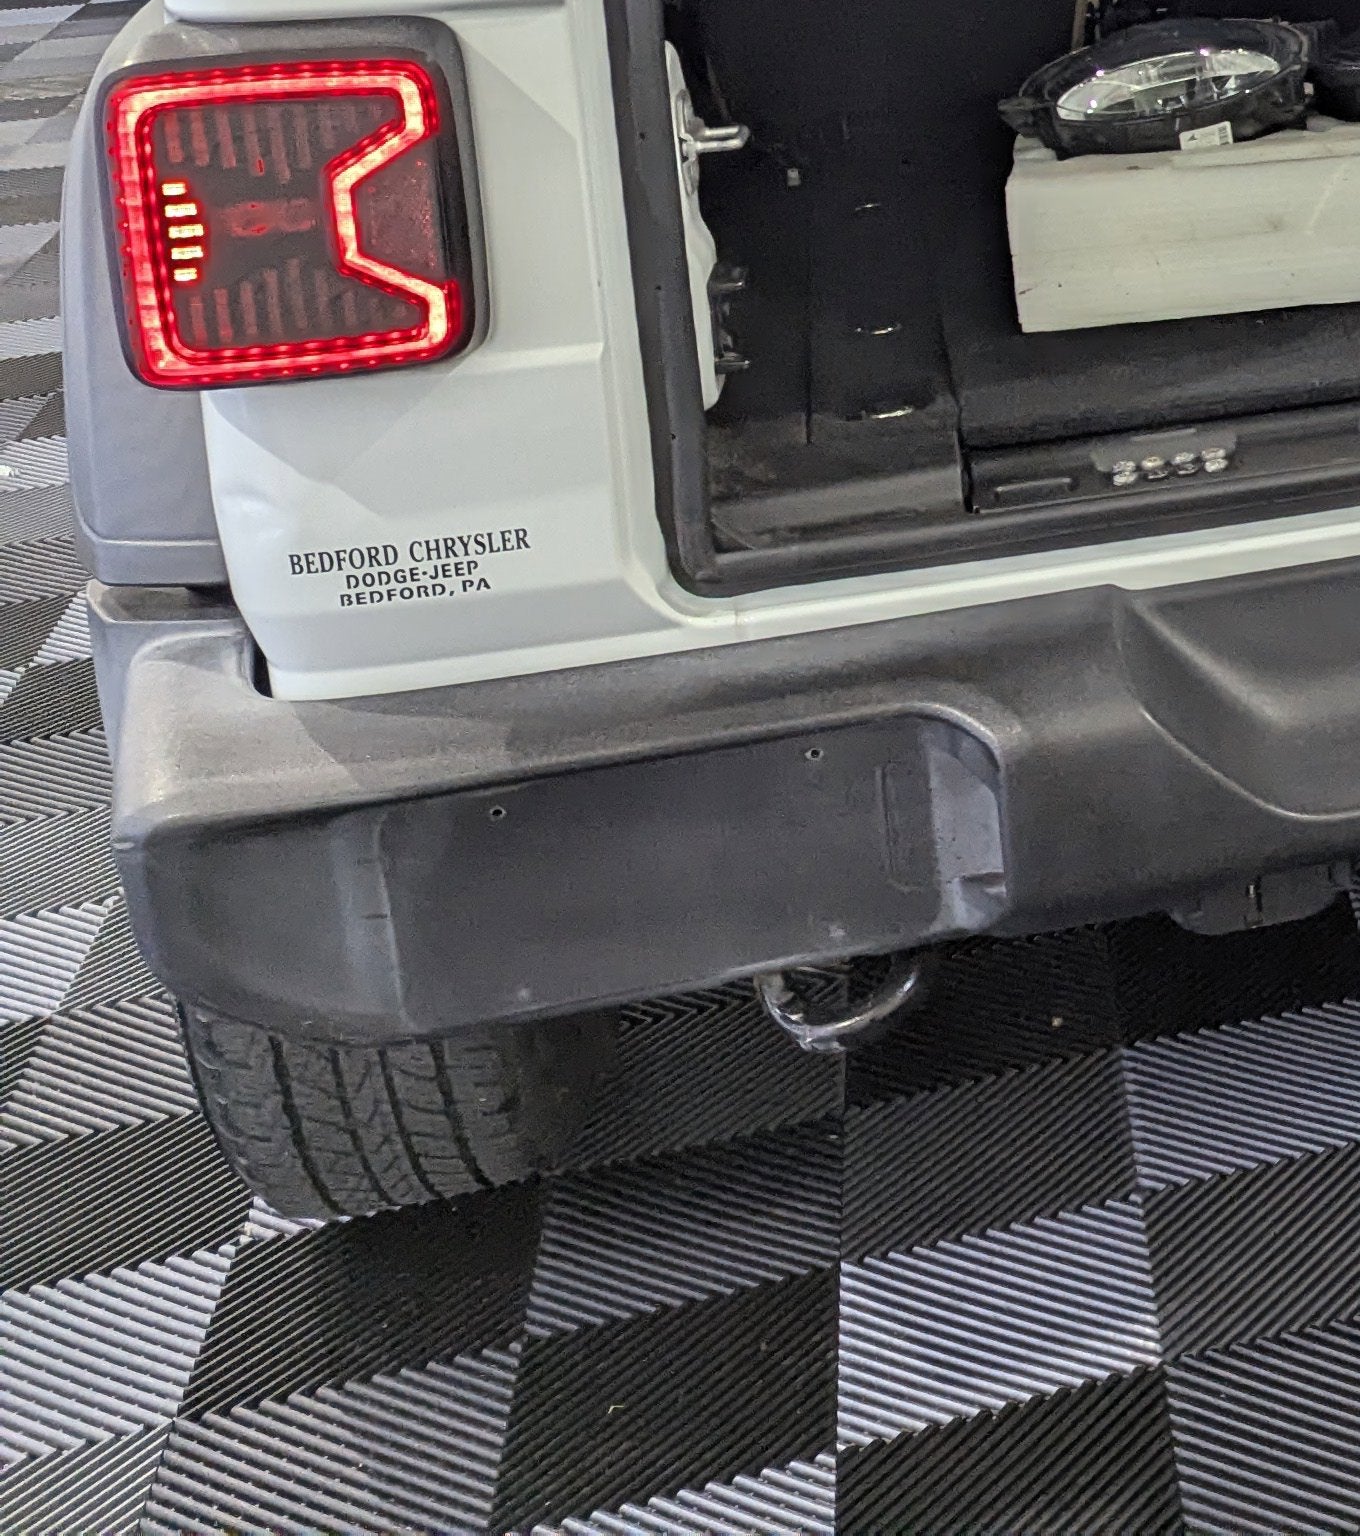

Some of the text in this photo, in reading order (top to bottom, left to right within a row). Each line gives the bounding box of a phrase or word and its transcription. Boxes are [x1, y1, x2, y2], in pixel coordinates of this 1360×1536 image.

[289, 528, 531, 575] BEDFORD CHRYSLER
[339, 577, 491, 607] BEDFORD, PA
